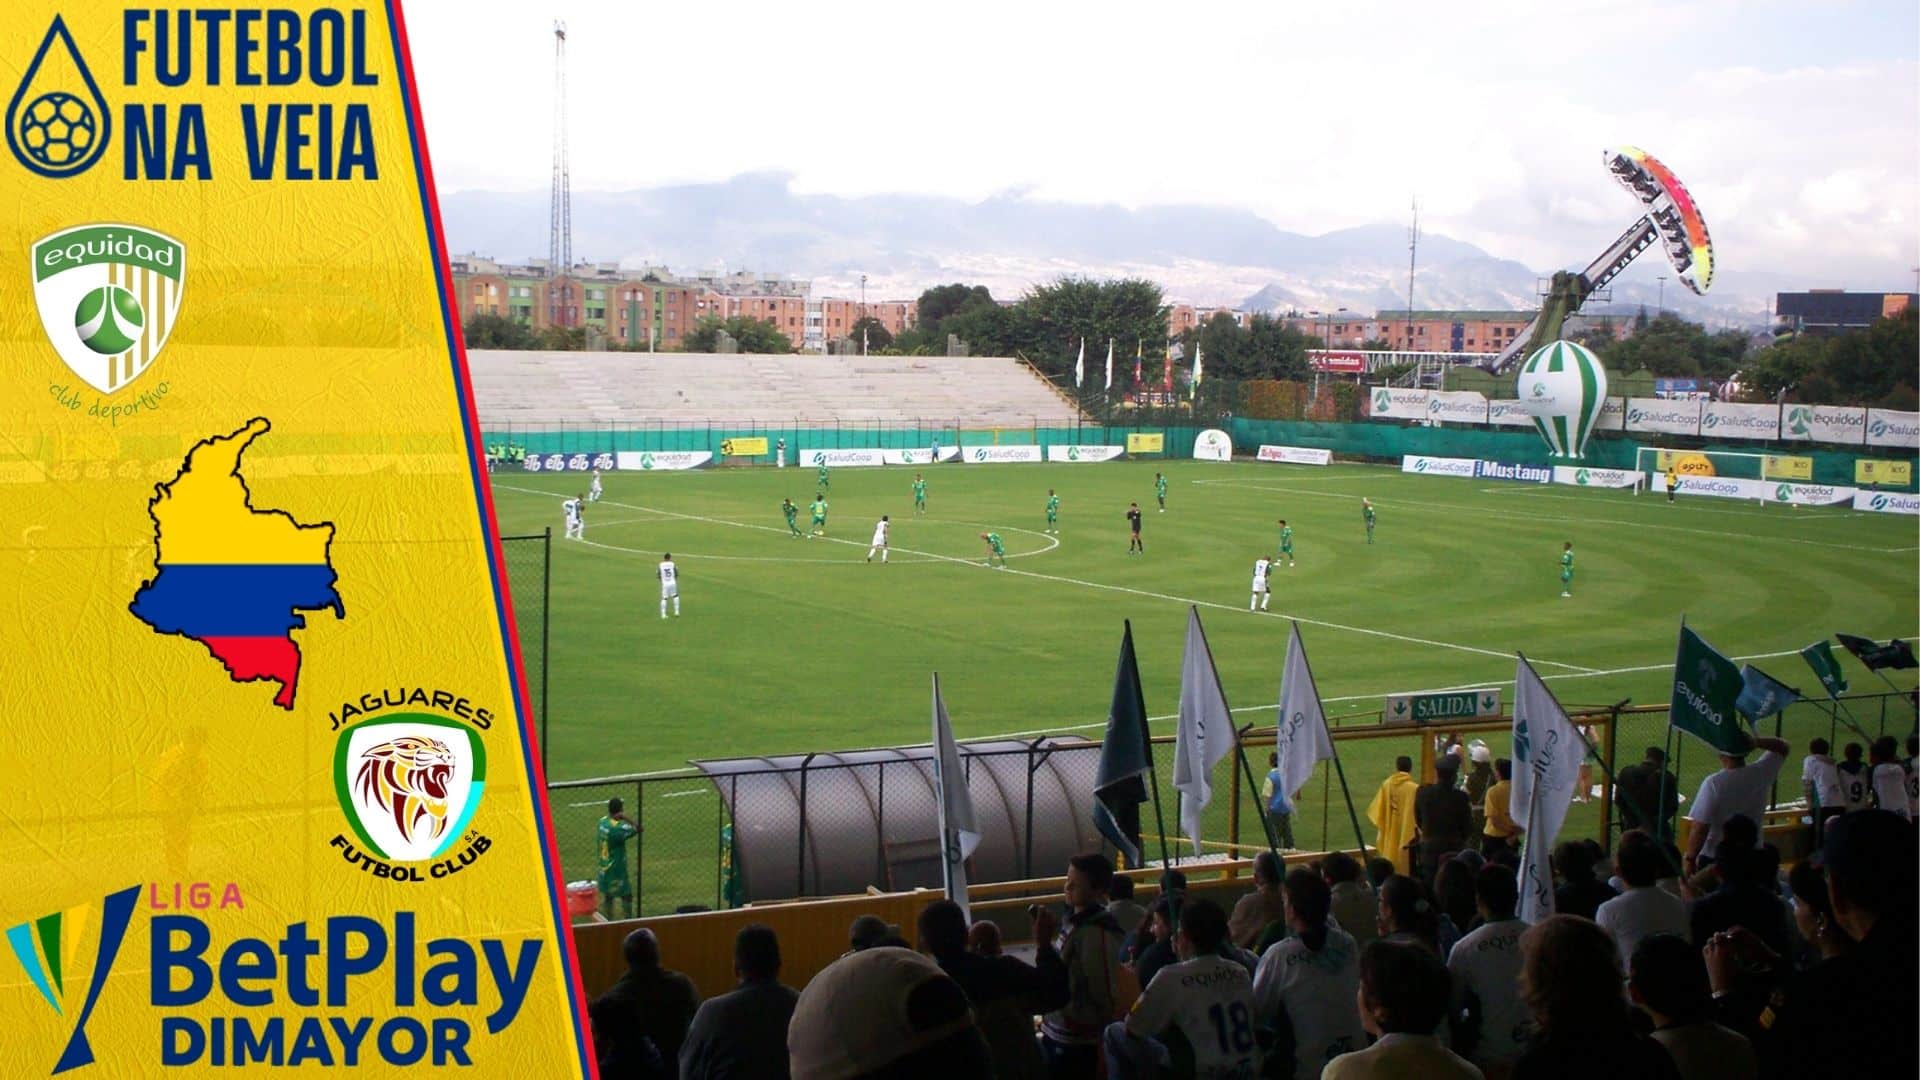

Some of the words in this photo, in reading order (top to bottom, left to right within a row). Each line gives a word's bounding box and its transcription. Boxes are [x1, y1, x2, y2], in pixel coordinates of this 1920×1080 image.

[1643, 409, 1698, 425] SaludCoop
[1720, 415, 1777, 430] SaludCoop
[1814, 412, 1865, 428] equidad
[1427, 461, 1471, 474] SaludCoop
[1482, 461, 1551, 484] Mustang
[1592, 470, 1625, 482] equidad
[1684, 479, 1738, 494] SaludCoop
[1794, 486, 1834, 498] equidad
[1417, 695, 1475, 717] SALIDA
[1850, 782, 1863, 803] 9
[1209, 1001, 1254, 1053] 18
